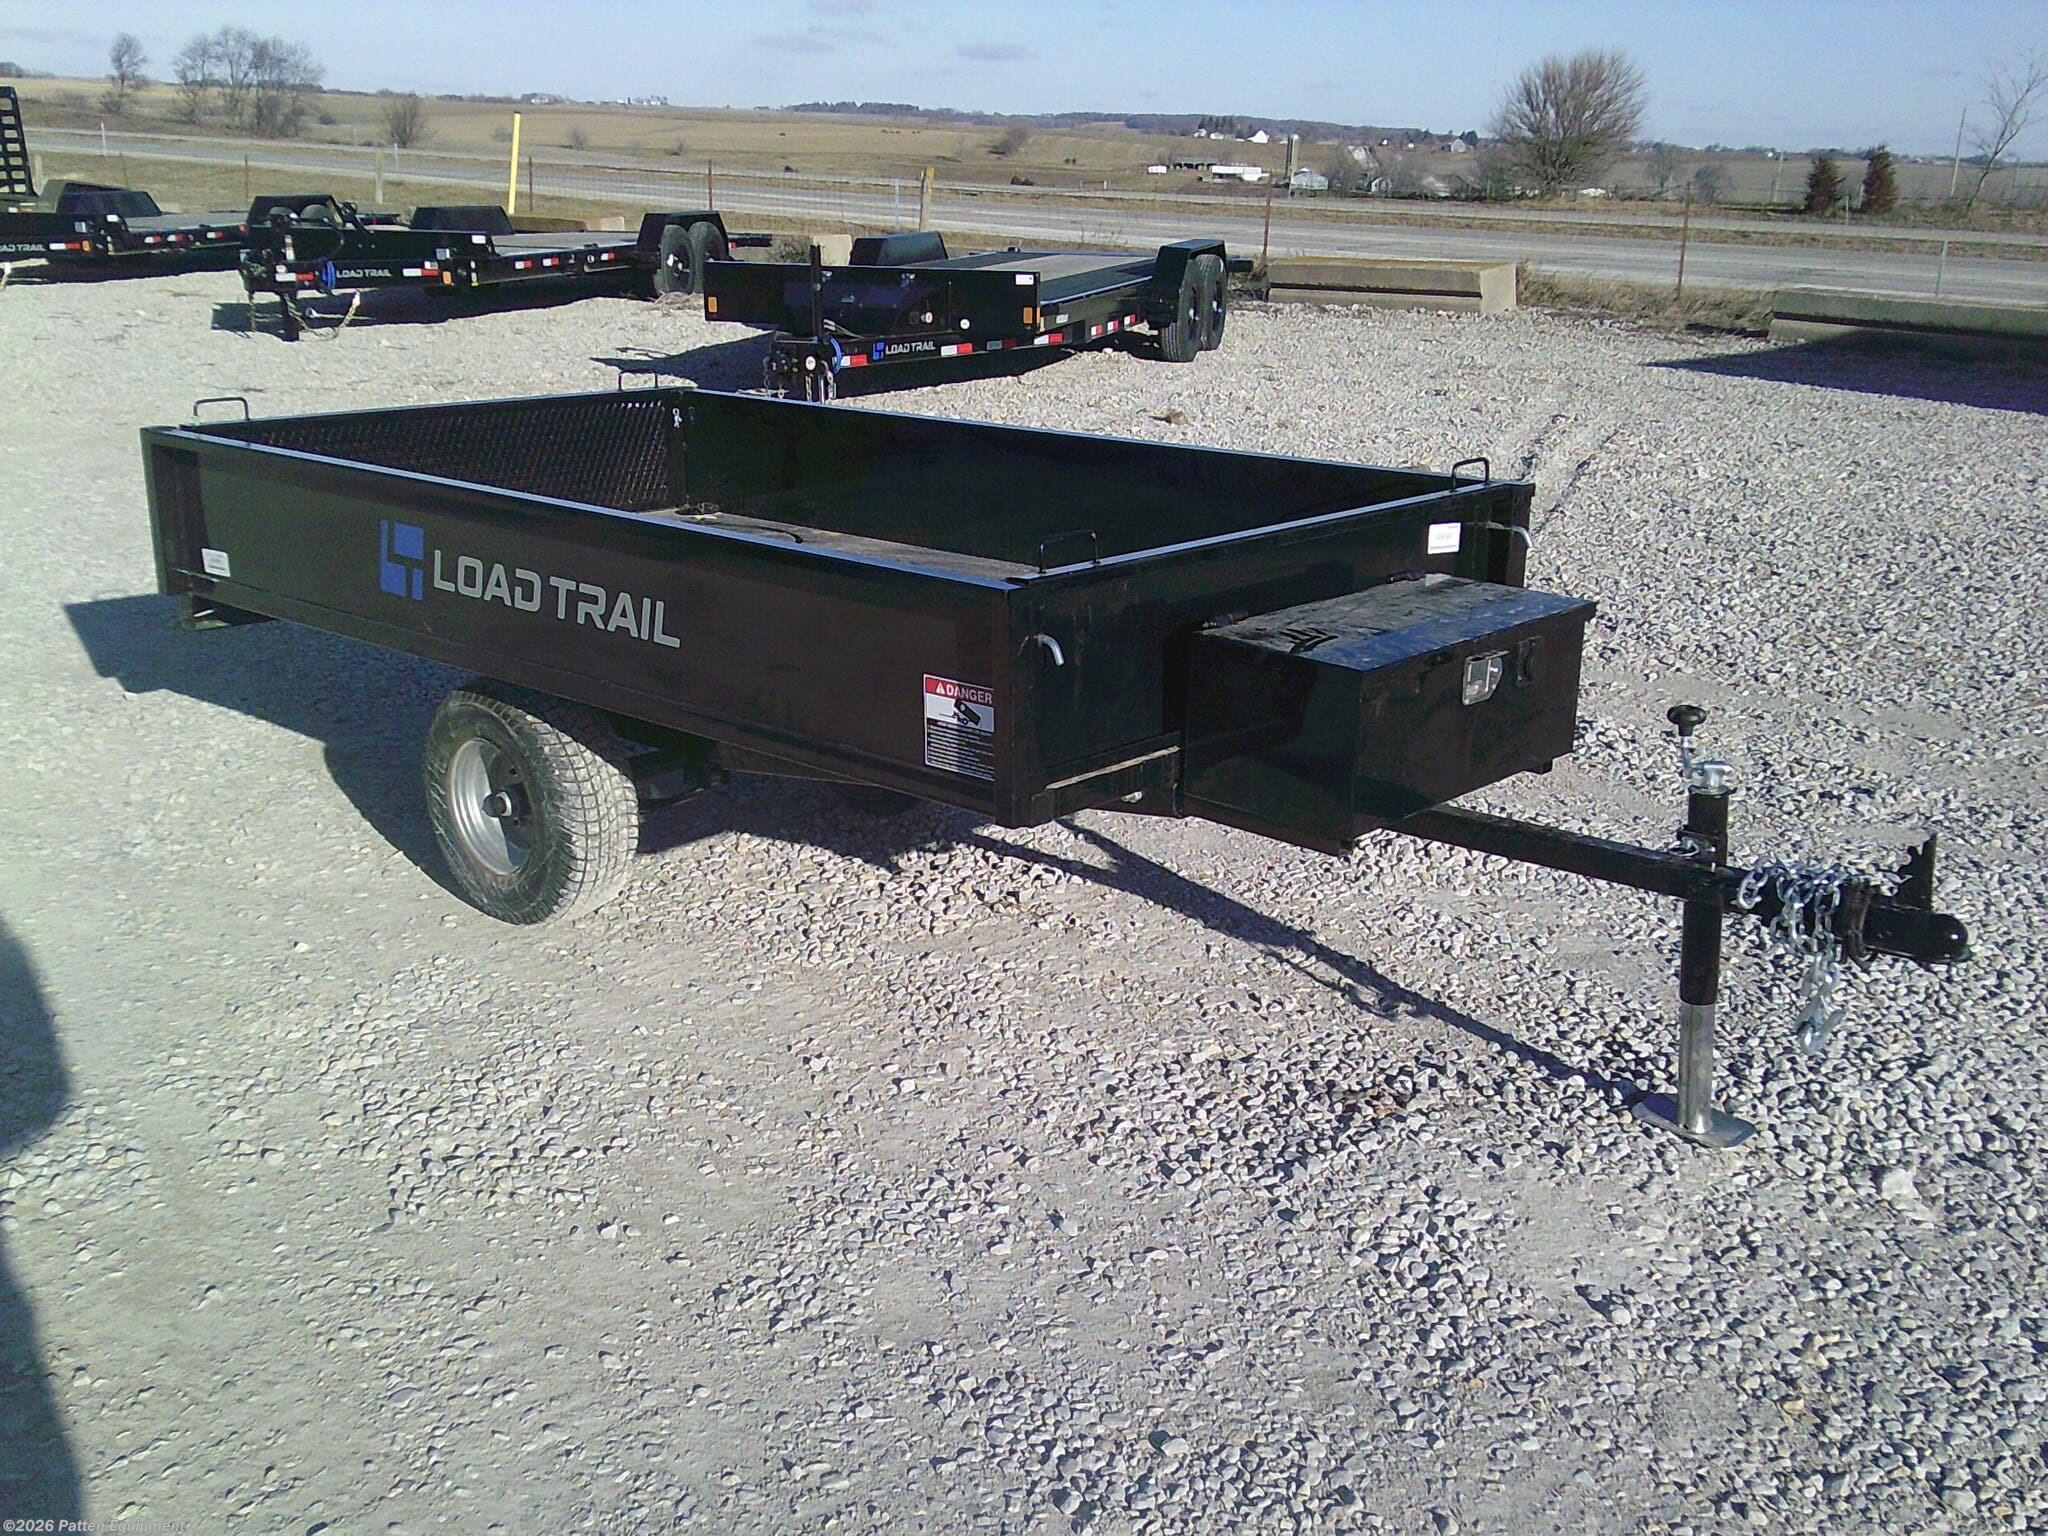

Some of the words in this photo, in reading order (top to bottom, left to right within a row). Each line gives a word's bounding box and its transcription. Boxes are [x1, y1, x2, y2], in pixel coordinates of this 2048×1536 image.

[17, 243, 47, 252] TRAIL
[336, 269, 363, 278] LOAD
[364, 269, 392, 277] TRAIL
[885, 343, 910, 355] LOAD
[911, 341, 936, 352] TRAIL
[433, 549, 542, 612] LOAD
[549, 575, 681, 648] TRAIL
[946, 684, 993, 705] DANGER
